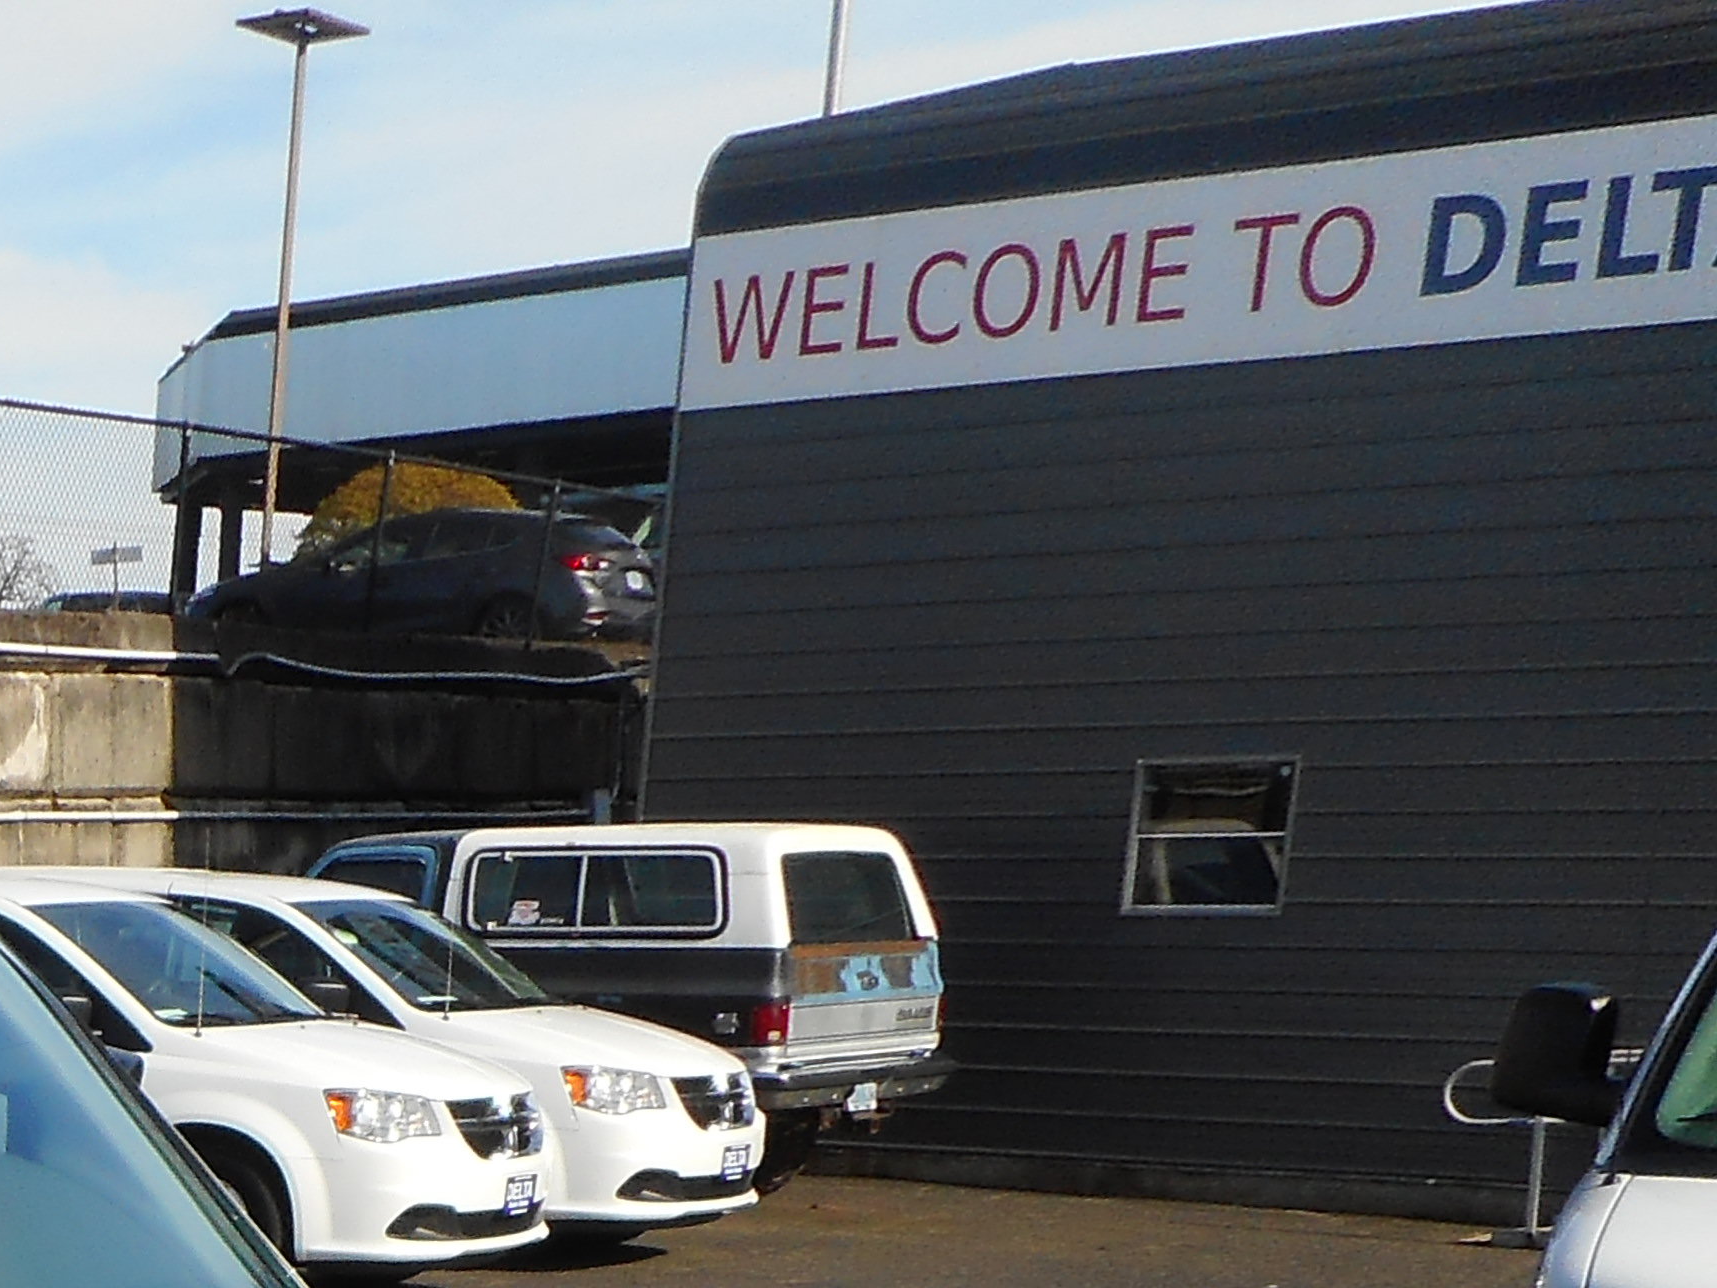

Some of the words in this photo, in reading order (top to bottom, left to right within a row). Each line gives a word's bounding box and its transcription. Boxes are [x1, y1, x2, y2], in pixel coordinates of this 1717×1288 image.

[714, 223, 1196, 365] WELCOME
[1233, 204, 1378, 313] TO
[1418, 163, 1717, 297] DELT
